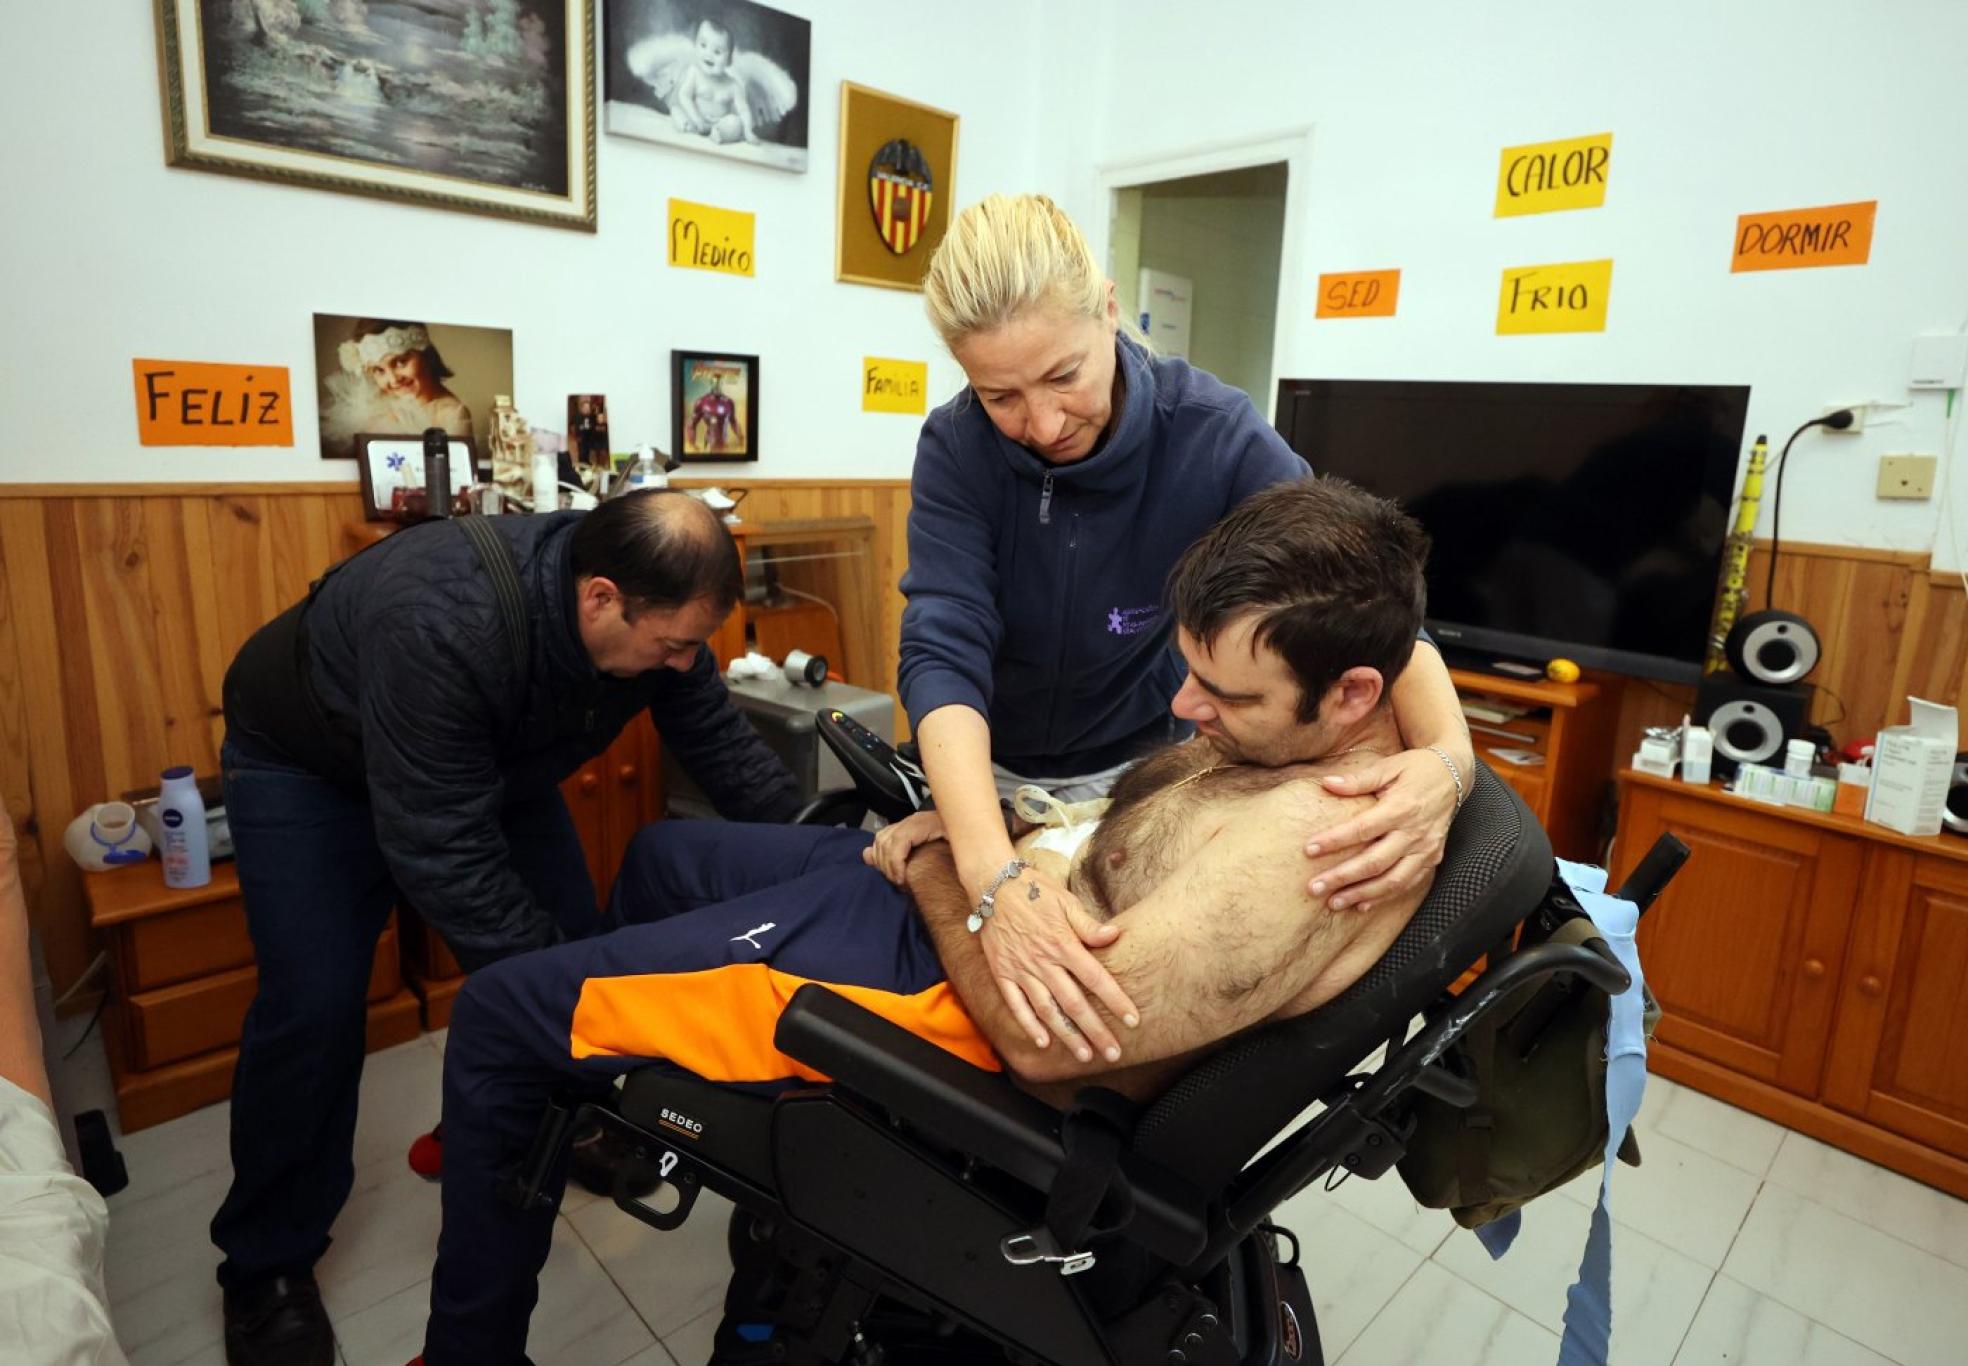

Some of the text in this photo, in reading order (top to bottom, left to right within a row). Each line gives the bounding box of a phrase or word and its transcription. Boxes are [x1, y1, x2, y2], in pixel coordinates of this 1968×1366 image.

[1506, 145, 1609, 198] CALOR
[1738, 219, 1852, 256] DORMIR
[1325, 278, 1381, 311] SED
[1507, 270, 1588, 315] FRIO
[660, 1107, 703, 1133] SEDEO
